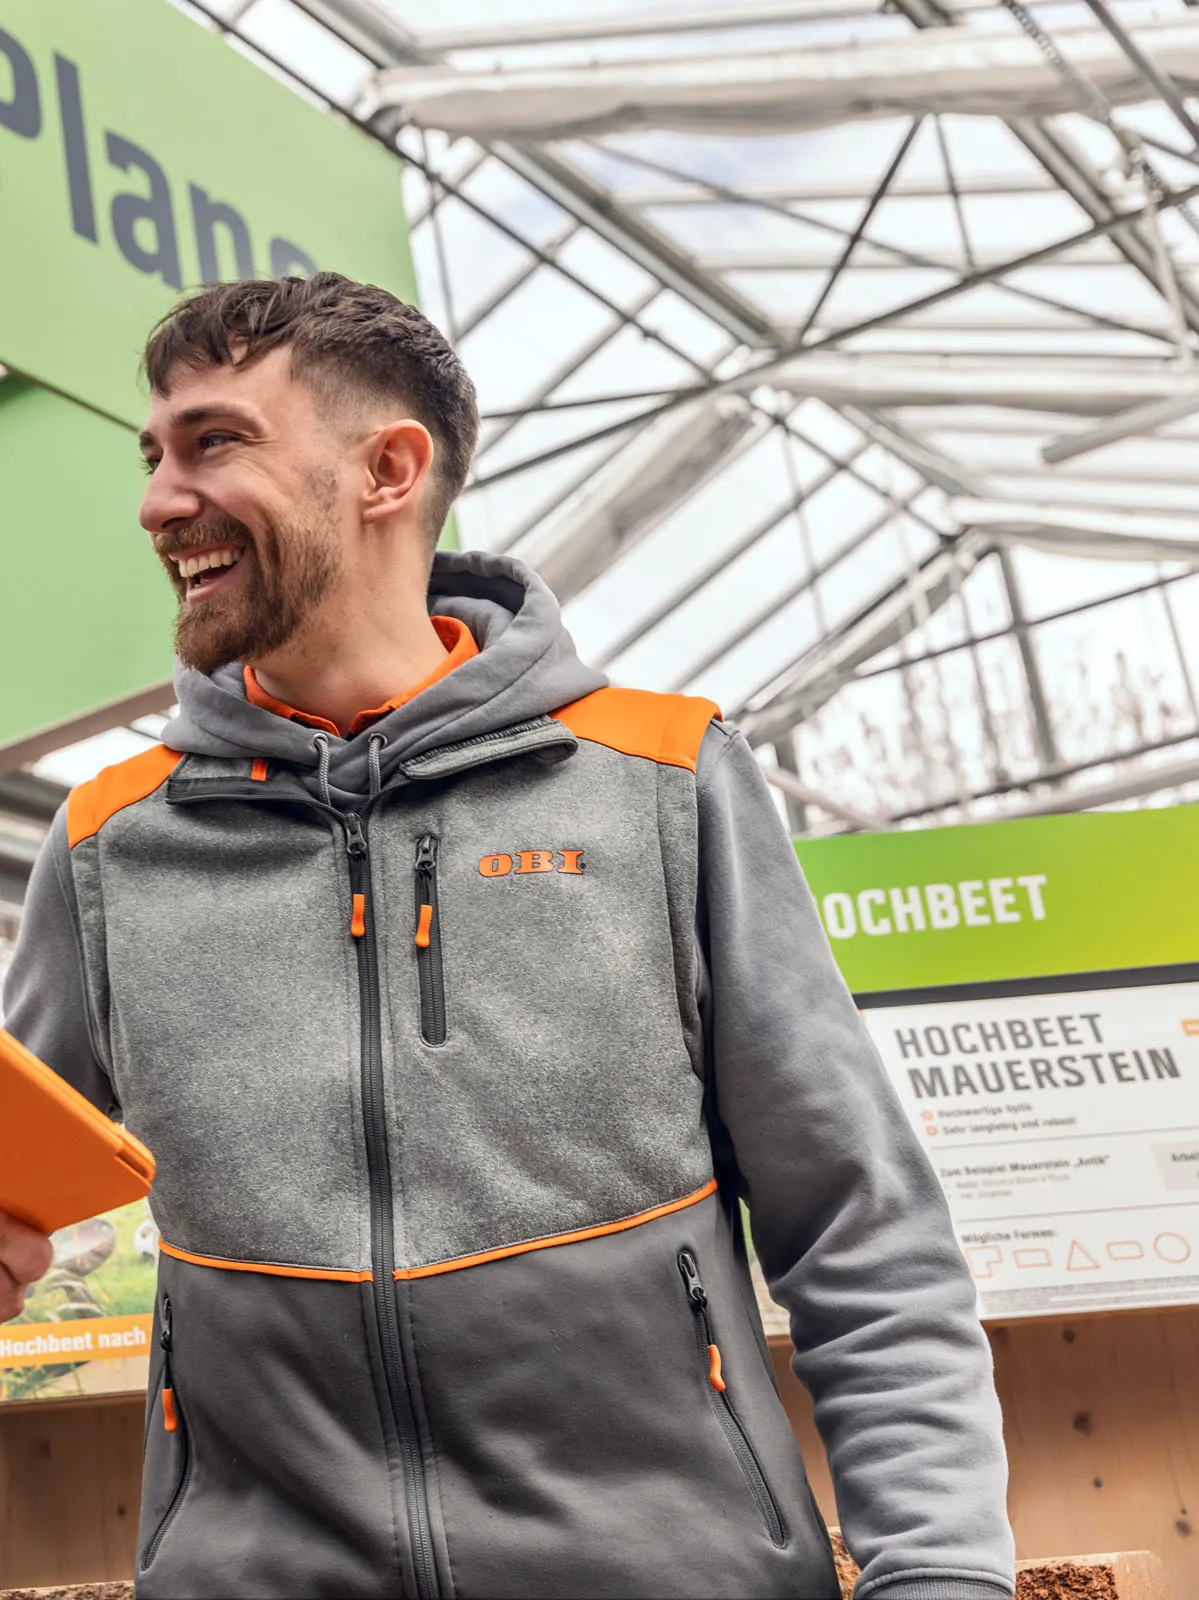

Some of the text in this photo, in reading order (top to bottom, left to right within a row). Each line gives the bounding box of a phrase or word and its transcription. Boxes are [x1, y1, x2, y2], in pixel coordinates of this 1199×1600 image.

[478, 849, 585, 878] OBI
[814, 875, 1047, 940] OCHBEET
[894, 1012, 1105, 1060] HOCHBEET
[907, 1047, 1182, 1100] MAUERSTEIN
[98, 1326, 146, 1350] nach
